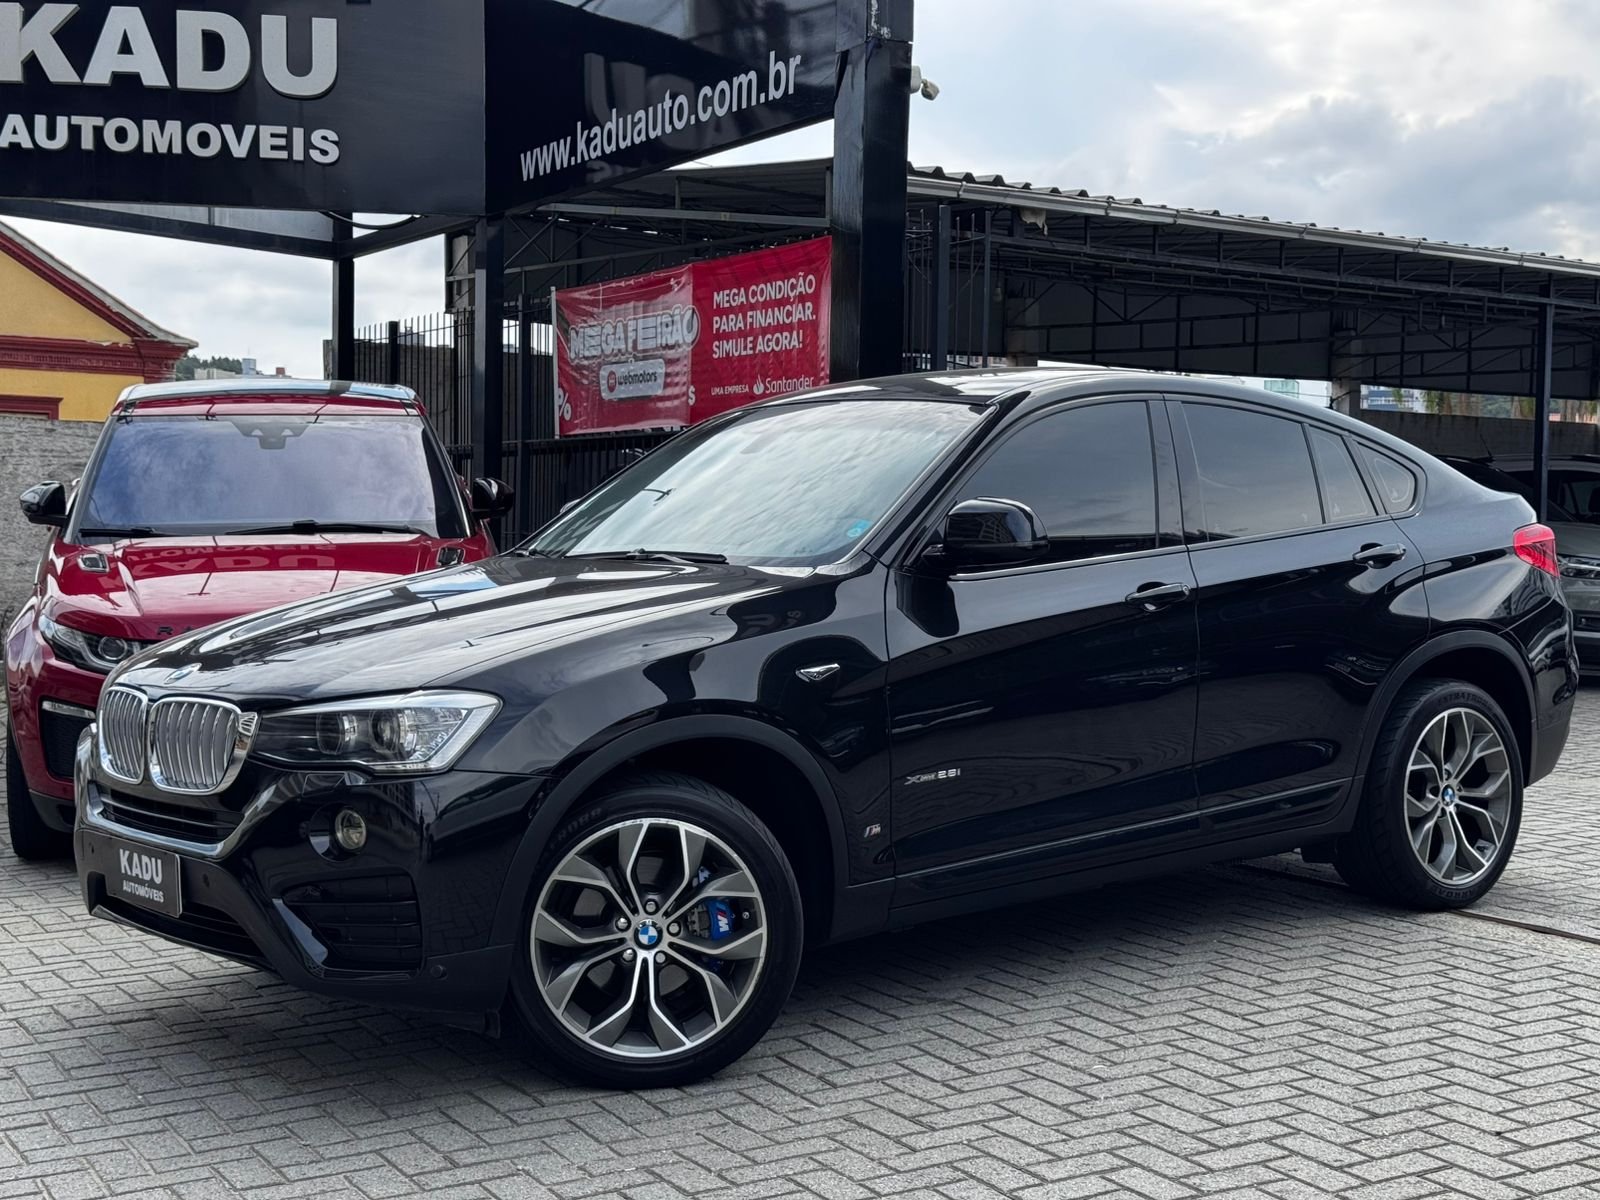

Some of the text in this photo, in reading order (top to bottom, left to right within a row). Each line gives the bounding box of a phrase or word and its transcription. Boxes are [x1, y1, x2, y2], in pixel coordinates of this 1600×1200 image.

[0, 2, 338, 99] KADU
[520, 50, 801, 181] www.kaduauto.com.br
[1, 114, 341, 165] AUTOMOVEIS
[713, 272, 816, 309] MEGA CONDIÇÃO
[570, 307, 699, 360] MEGA FEIRÃO
[713, 302, 816, 334] PARA FINANCIAR.
[712, 330, 803, 359] SIMULE AGORA!
[618, 370, 657, 386] webmotors
[711, 384, 749, 396] UMA EMPRESA
[765, 375, 814, 394] Santander
[119, 848, 163, 885] KADU
[122, 879, 164, 903] AUTOMÓVEIS
